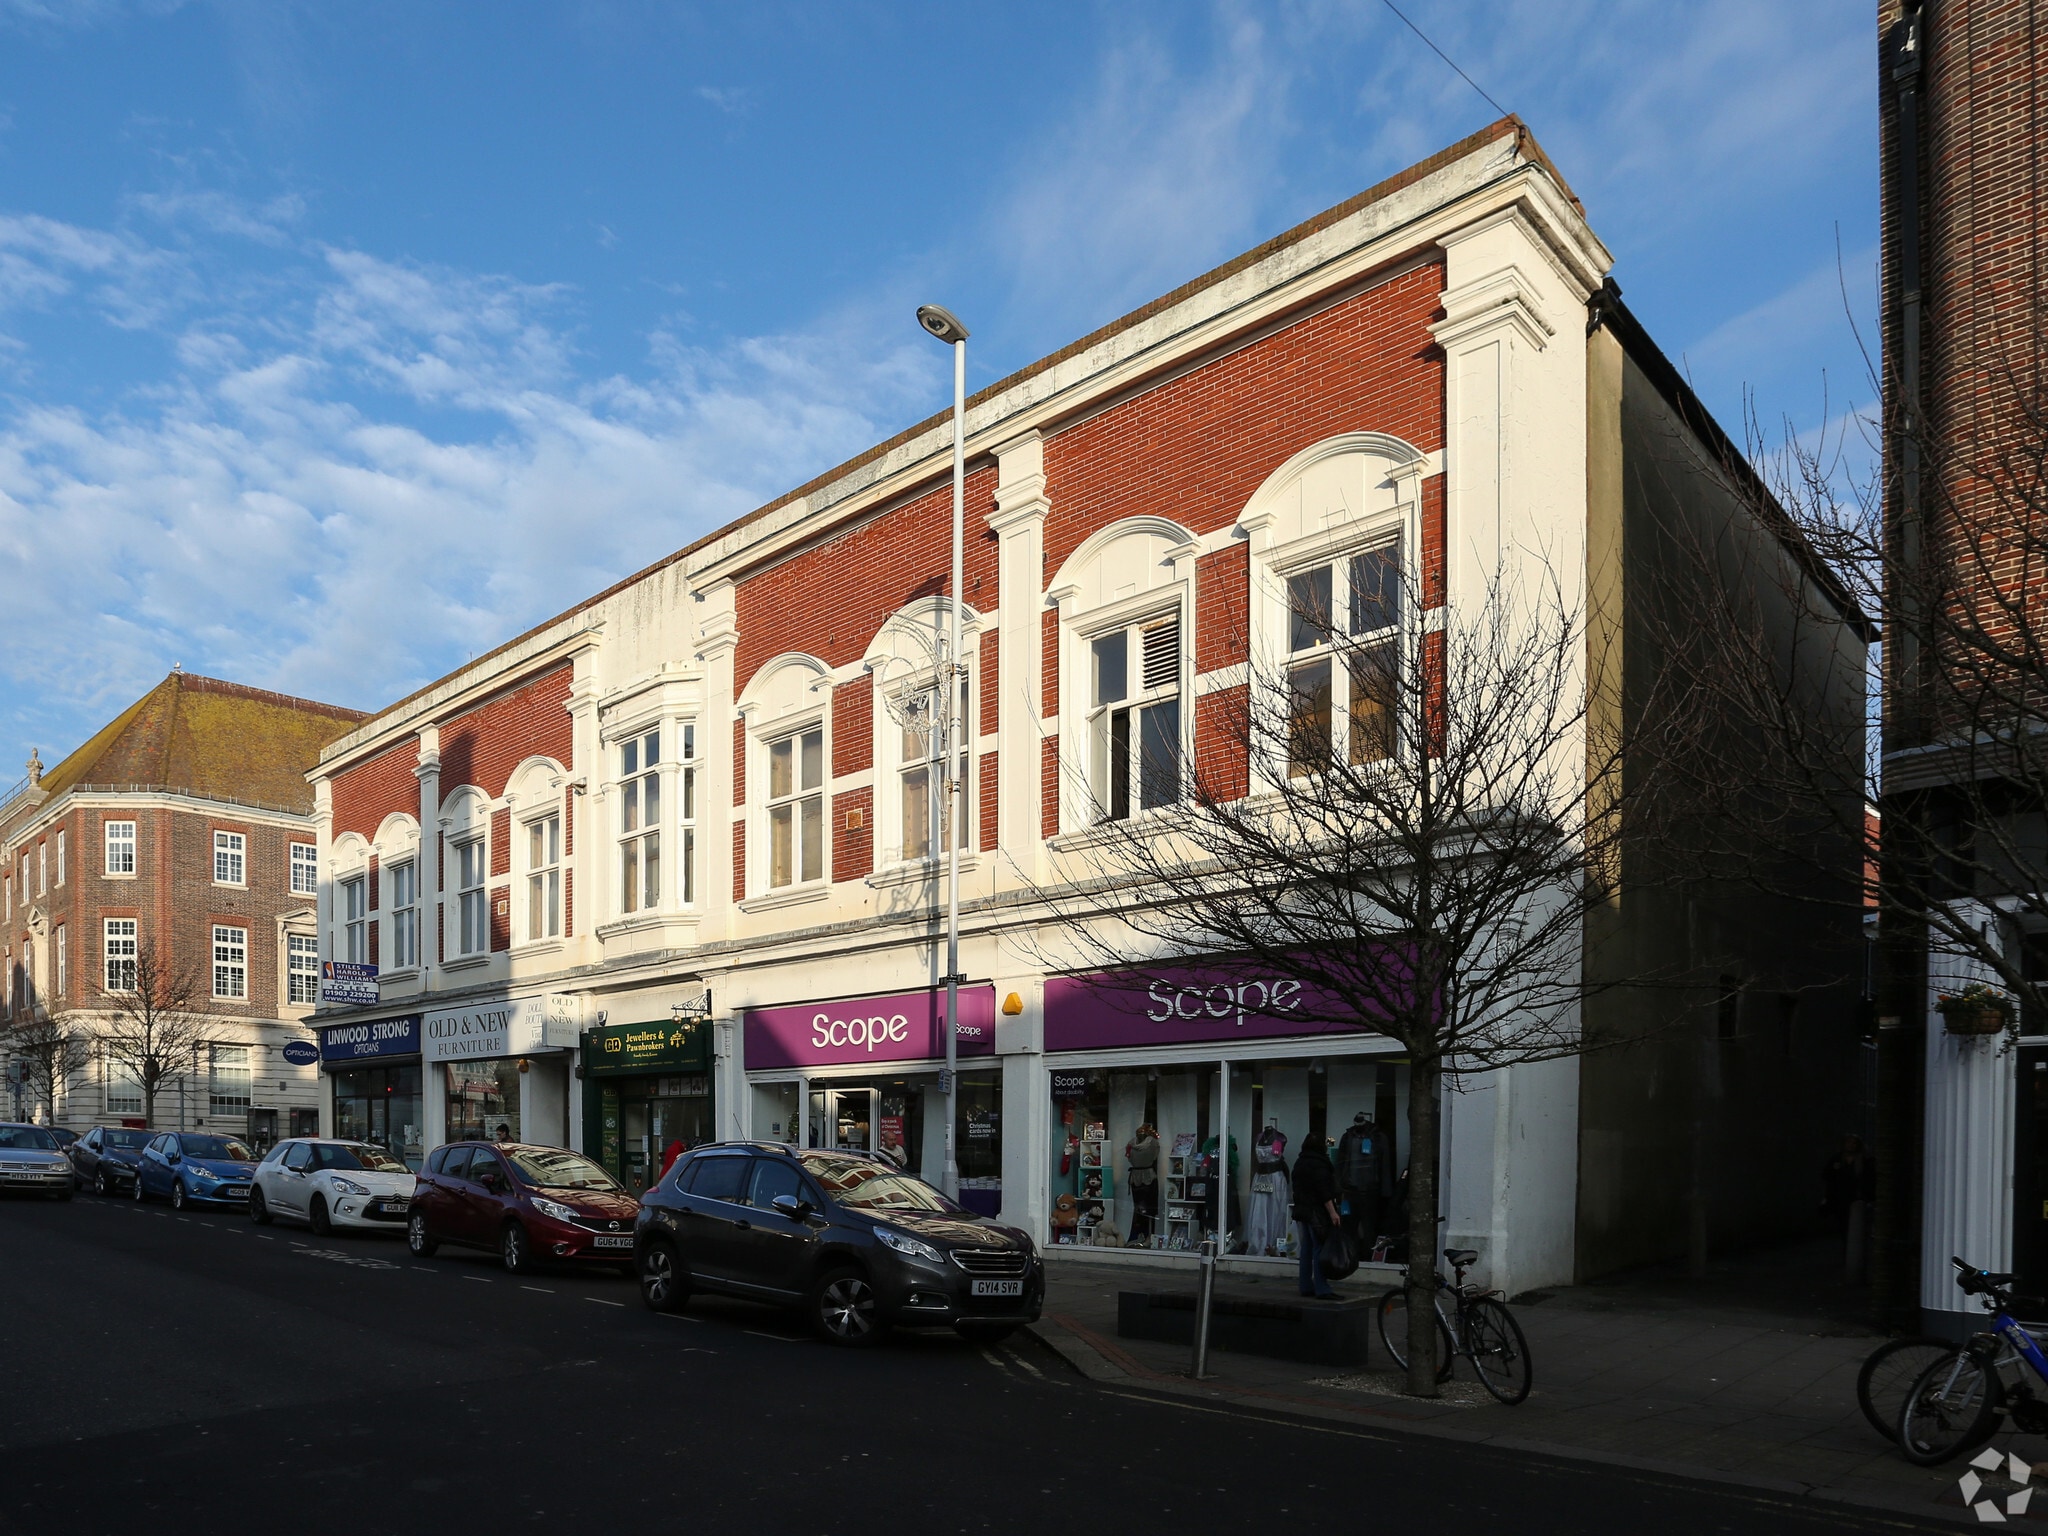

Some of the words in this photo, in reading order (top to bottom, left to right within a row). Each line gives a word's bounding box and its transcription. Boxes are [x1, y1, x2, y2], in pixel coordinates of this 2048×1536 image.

[336, 963, 361, 971] STILES
[324, 996, 377, 1004] www.shw.co.uk
[350, 991, 376, 999] 229200
[551, 998, 573, 1006] OLD
[1147, 978, 1302, 1026] Scope
[558, 1007, 566, 1015] &
[429, 1016, 457, 1039] OLD
[461, 1015, 471, 1035] &
[475, 1010, 511, 1034] NEW
[550, 1015, 575, 1024] NEW
[328, 1026, 369, 1045] LINWOOD
[372, 1020, 410, 1040] STRONG
[812, 1013, 908, 1052] Scope
[956, 1023, 981, 1036] Scope
[625, 1032, 657, 1043] Jewellers
[658, 1030, 664, 1040] &
[354, 1042, 379, 1054] OPTICIANS
[438, 1037, 500, 1056] FURNITURE
[626, 1041, 665, 1052] Pawnbrokers
[1055, 1075, 1085, 1089] Scope
[597, 1238, 617, 1246] GU64
[978, 1282, 999, 1293] GY14
[1001, 1282, 1018, 1293] SVR
